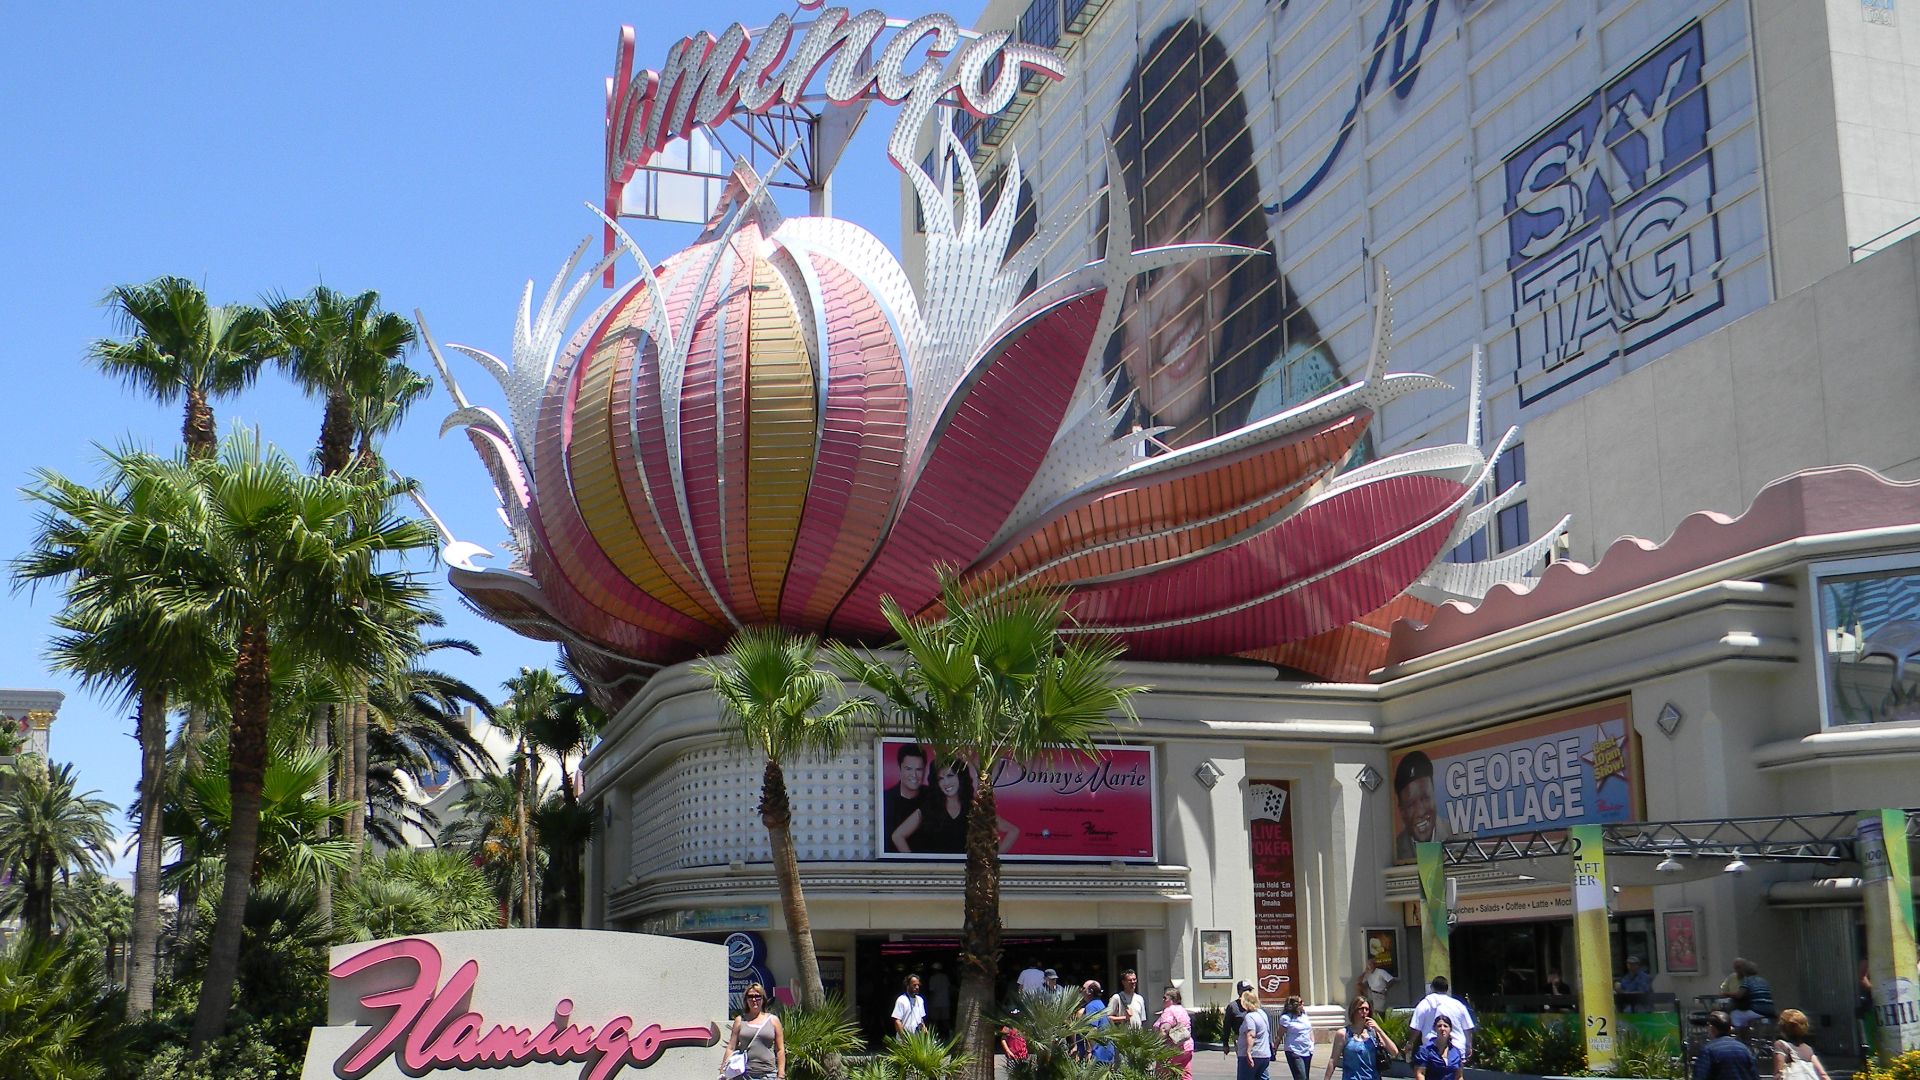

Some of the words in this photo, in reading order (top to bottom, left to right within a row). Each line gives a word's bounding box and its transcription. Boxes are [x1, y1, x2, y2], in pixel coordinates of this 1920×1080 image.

[1515, 48, 1691, 258] SKY
[1521, 197, 1692, 373] TAG
[992, 758, 1073, 791] Donny
[1051, 760, 1146, 795] Marie
[1074, 772, 1083, 784] &
[1445, 737, 1582, 798] GEORGE
[1445, 777, 1585, 836] WALLACE
[1252, 824, 1282, 840] LIVE
[1253, 841, 1291, 856] OKER
[1574, 875, 1596, 886] ER
[1575, 862, 1601, 873] AFT
[1479, 903, 1500, 913] Salads
[1505, 901, 1527, 911] Coffee
[1532, 900, 1549, 909] Latte
[1555, 898, 1572, 907] Moc
[329, 939, 718, 1080] Flamingo
